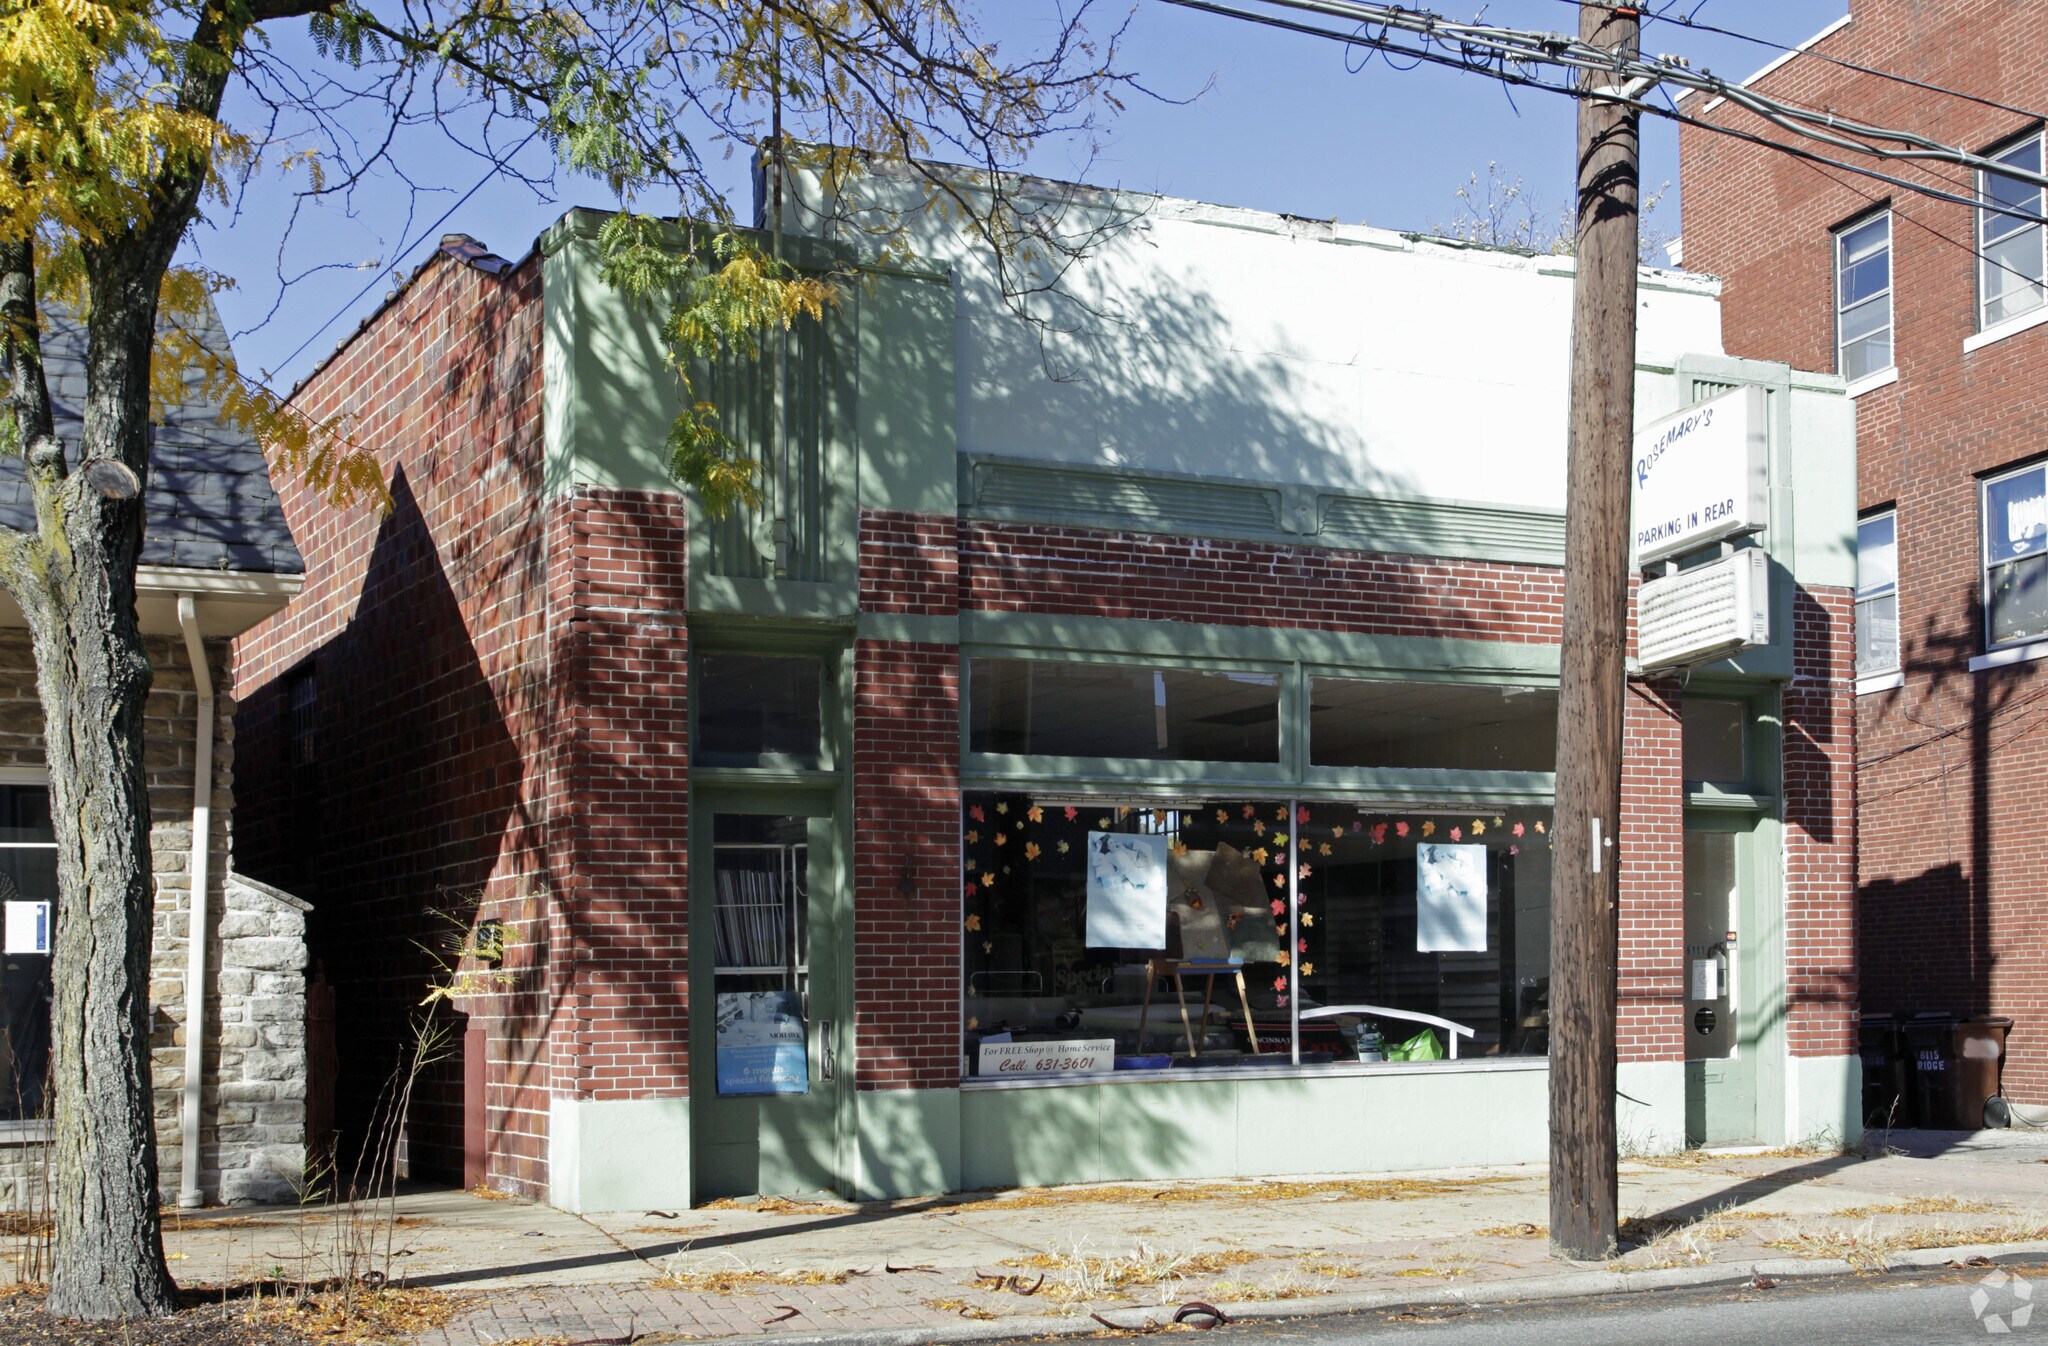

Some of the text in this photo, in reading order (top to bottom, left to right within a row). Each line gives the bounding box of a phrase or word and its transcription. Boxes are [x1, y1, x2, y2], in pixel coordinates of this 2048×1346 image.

[1637, 408, 1714, 489] ROSEMARY'S
[1638, 498, 1734, 547] PARKING IN REAR
[1055, 964, 1113, 988] Specia
[984, 1044, 1111, 1057] For FREE Shop @ Home Service
[743, 1066, 784, 1075] 6 month
[999, 1057, 1095, 1072] Call: 631-3601
[1917, 1060, 1945, 1071] RIDGE
[726, 1075, 800, 1086] special financing
